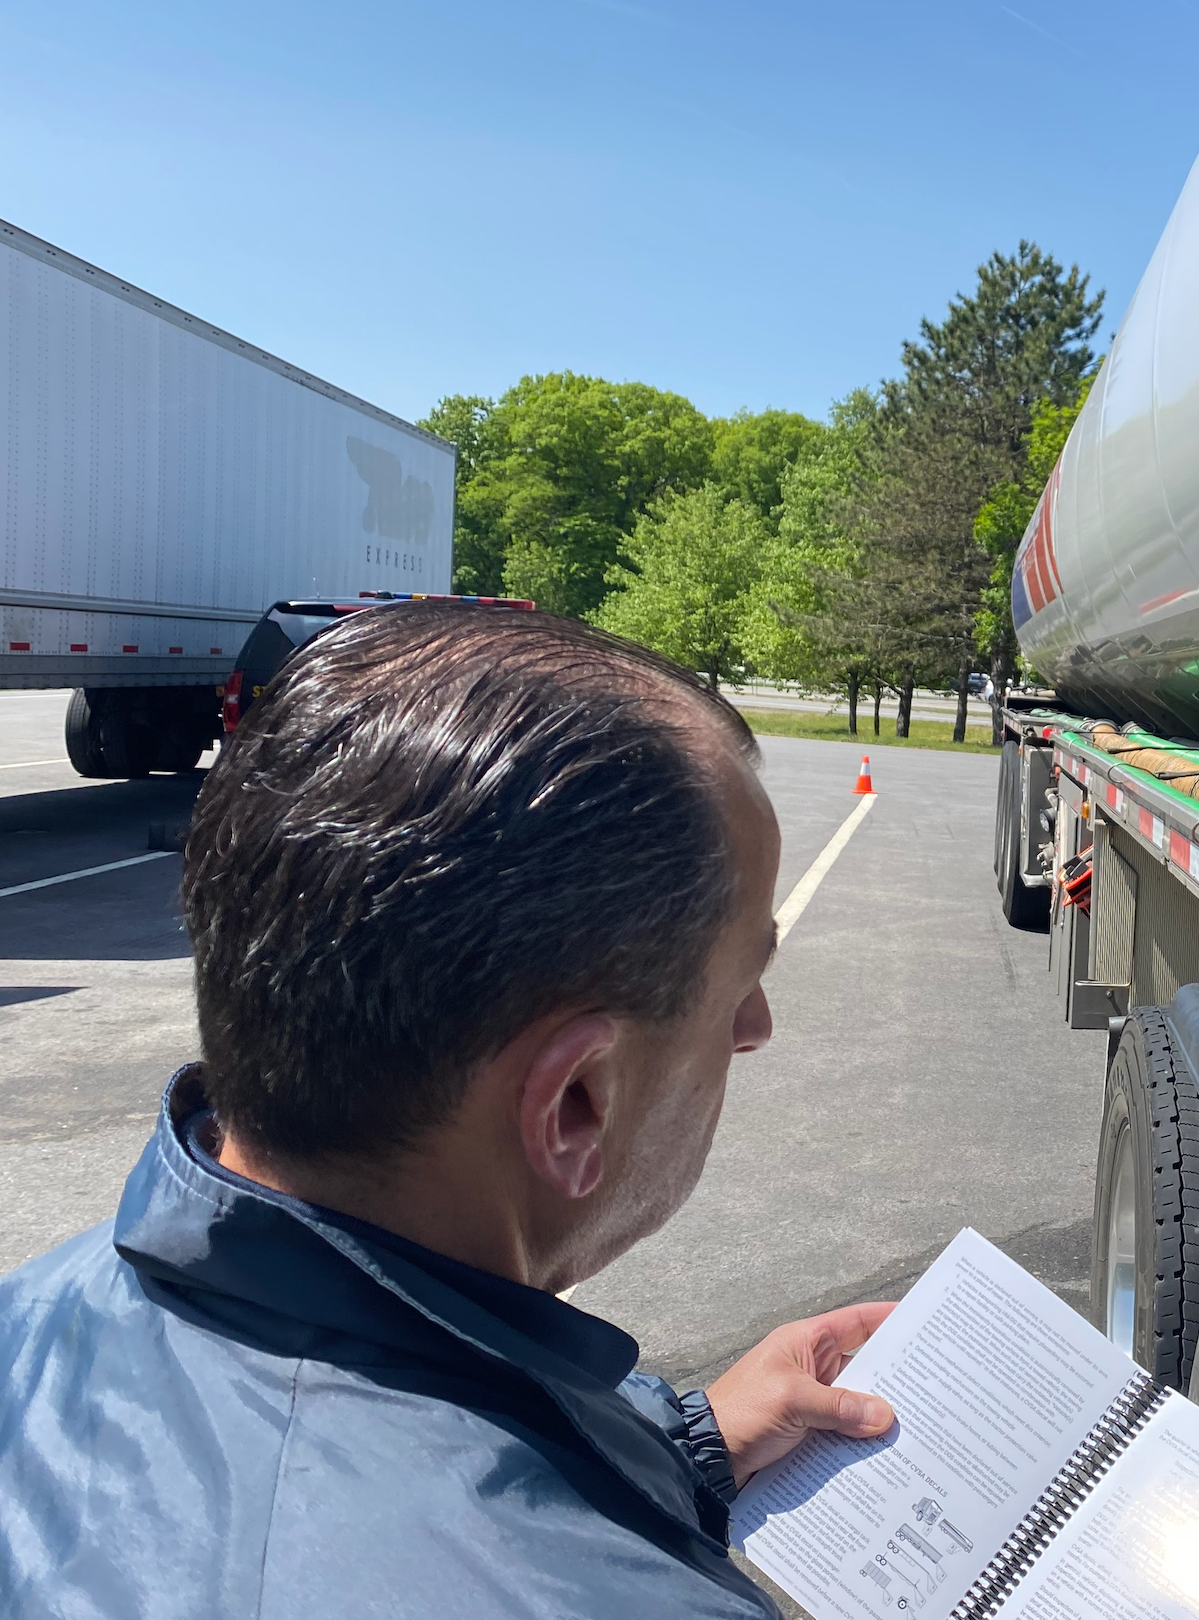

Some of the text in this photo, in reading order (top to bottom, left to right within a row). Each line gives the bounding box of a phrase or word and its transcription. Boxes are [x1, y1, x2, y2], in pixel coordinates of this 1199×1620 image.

[366, 545, 422, 573] EXPRESS
[874, 1434, 948, 1498] LOCATION OF CVSA DECALS
